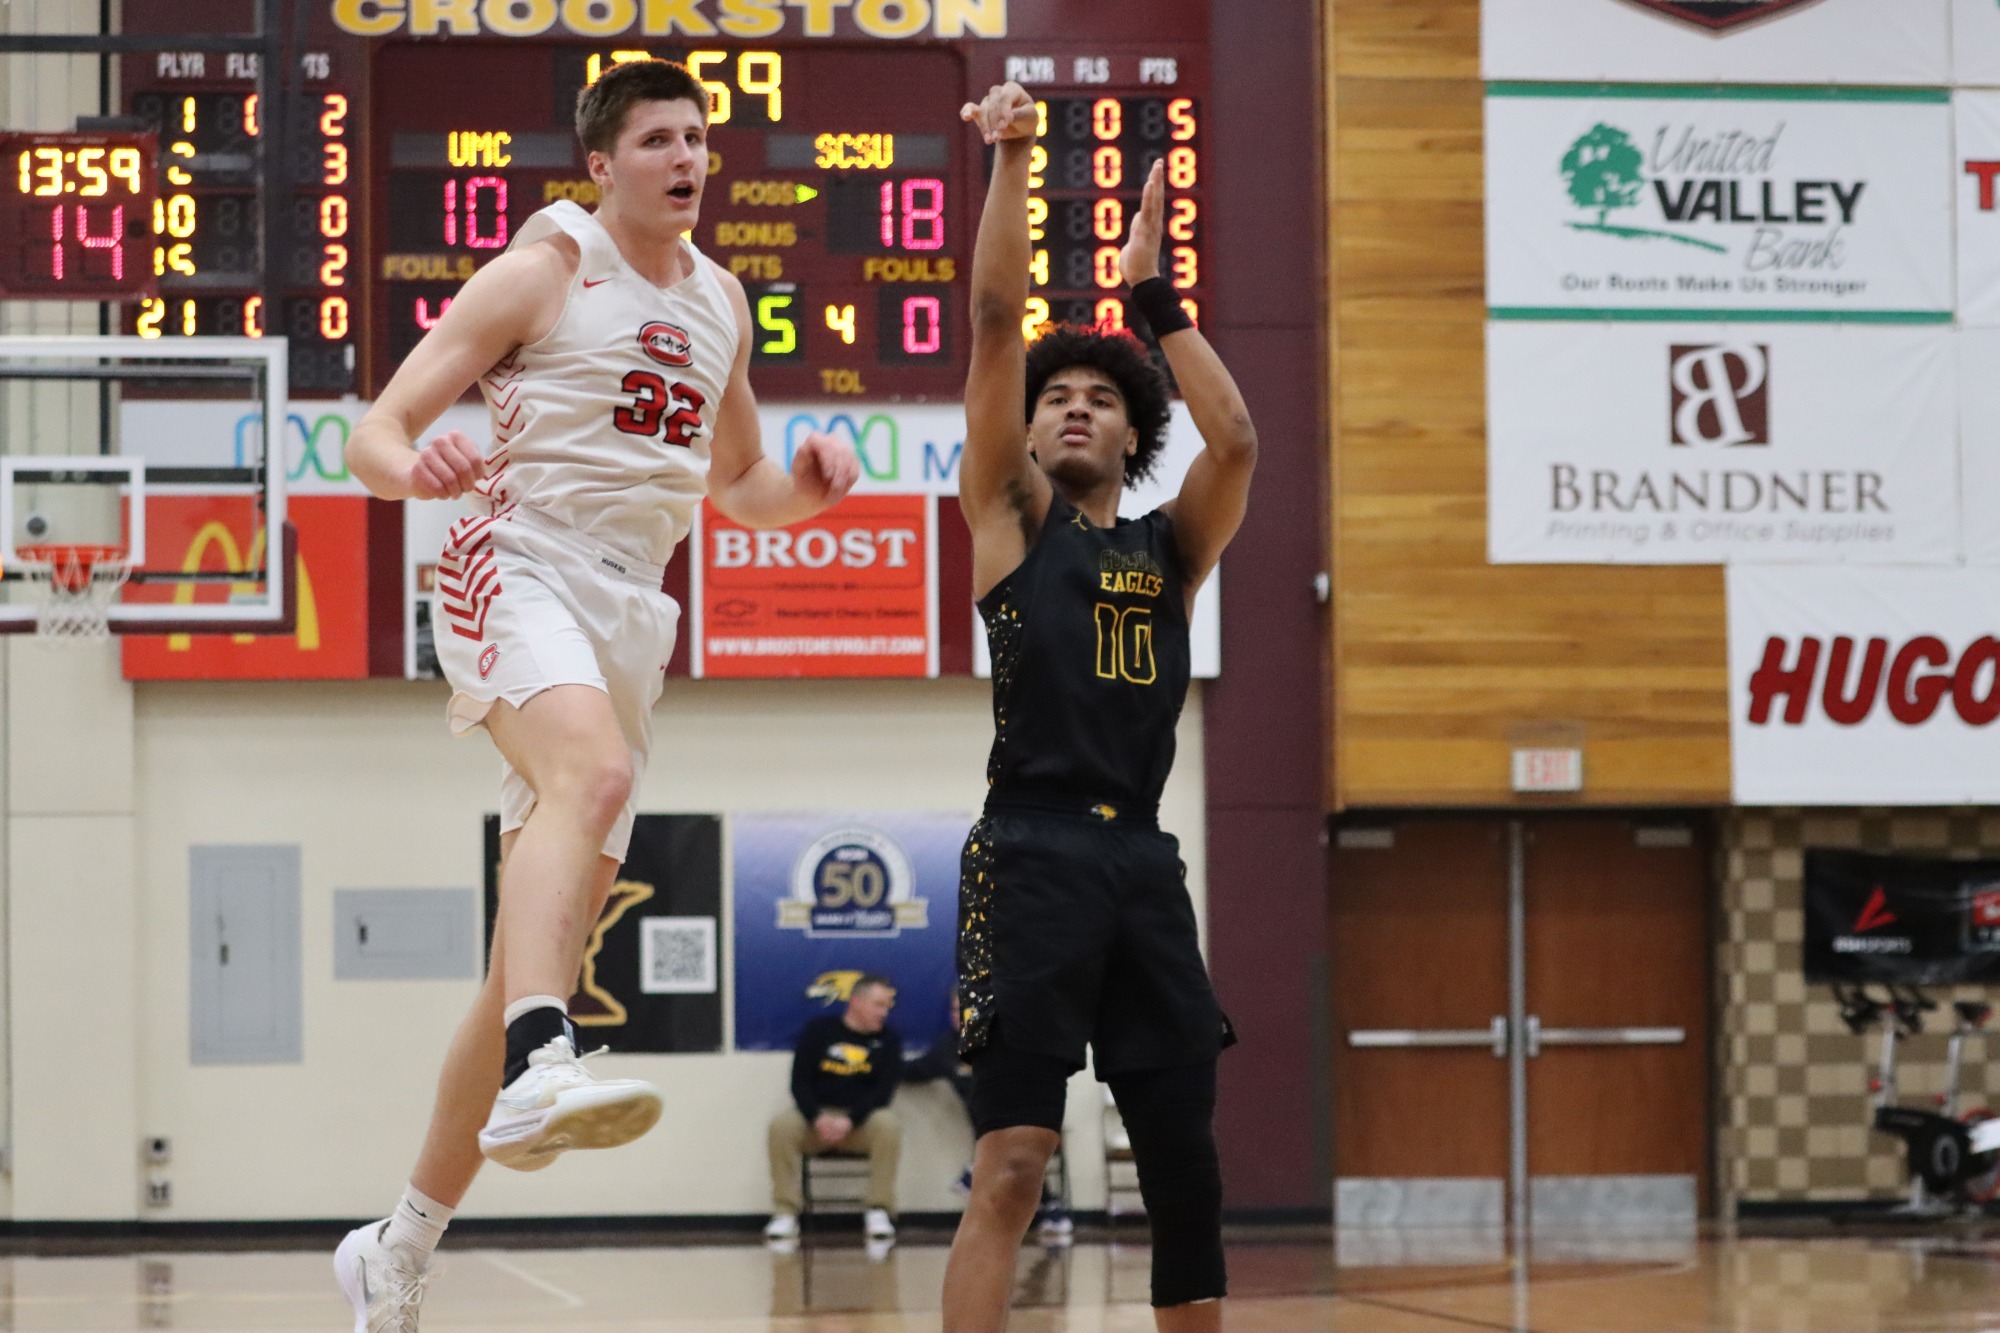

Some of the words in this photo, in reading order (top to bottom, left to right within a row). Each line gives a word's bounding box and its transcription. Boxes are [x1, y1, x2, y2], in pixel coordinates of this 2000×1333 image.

[331, 0, 1008, 38] CROOKSTON
[157, 53, 205, 79] PLYR
[301, 53, 330, 79] TS
[1005, 55, 1055, 83] PLYR
[1073, 57, 1109, 83] FLS
[1139, 57, 1178, 84] PTS
[320, 94, 348, 136] 2
[1093, 98, 1122, 140] 0
[1167, 98, 1197, 141] 5
[323, 143, 348, 184] 3
[449, 131, 512, 167] UMC
[815, 133, 893, 169] SCSU
[1093, 146, 1122, 188] 0
[1167, 146, 1197, 189] 8
[1651, 122, 1786, 175] United
[18, 147, 141, 197] 13:59
[444, 177, 508, 248] 10
[731, 182, 796, 206] POSS
[880, 179, 945, 250] 18
[1653, 180, 1866, 223] VALLEY
[152, 194, 196, 238] 10
[320, 195, 348, 238] 0
[716, 223, 797, 247] BONUS
[1094, 198, 1123, 241] 0
[1168, 198, 1197, 241] 2
[52, 204, 124, 281] 14
[1743, 225, 1845, 272] Bank
[320, 243, 348, 287] 2
[384, 256, 475, 280] FOULS
[730, 256, 783, 280] PTS
[864, 258, 955, 282] FOULS
[1094, 246, 1123, 288] 0
[1171, 246, 1198, 289] 3
[1560, 275, 1600, 292] Our
[1608, 275, 1668, 292] Roots
[1676, 275, 1733, 292] Make
[1741, 275, 1768, 292] Us
[1775, 276, 1867, 296] Stronger
[320, 297, 348, 340] 0
[757, 296, 796, 354] 5
[825, 304, 856, 345] 4
[902, 297, 940, 354] 0
[821, 369, 865, 394] TOL
[613, 369, 707, 447] 32
[1549, 463, 1891, 513] BRANDNER
[713, 530, 917, 569] BROST
[1100, 571, 1164, 598] EAGLES
[1094, 602, 1157, 685] 10
[1748, 634, 2000, 726] HUGO
[821, 862, 885, 909] 50
